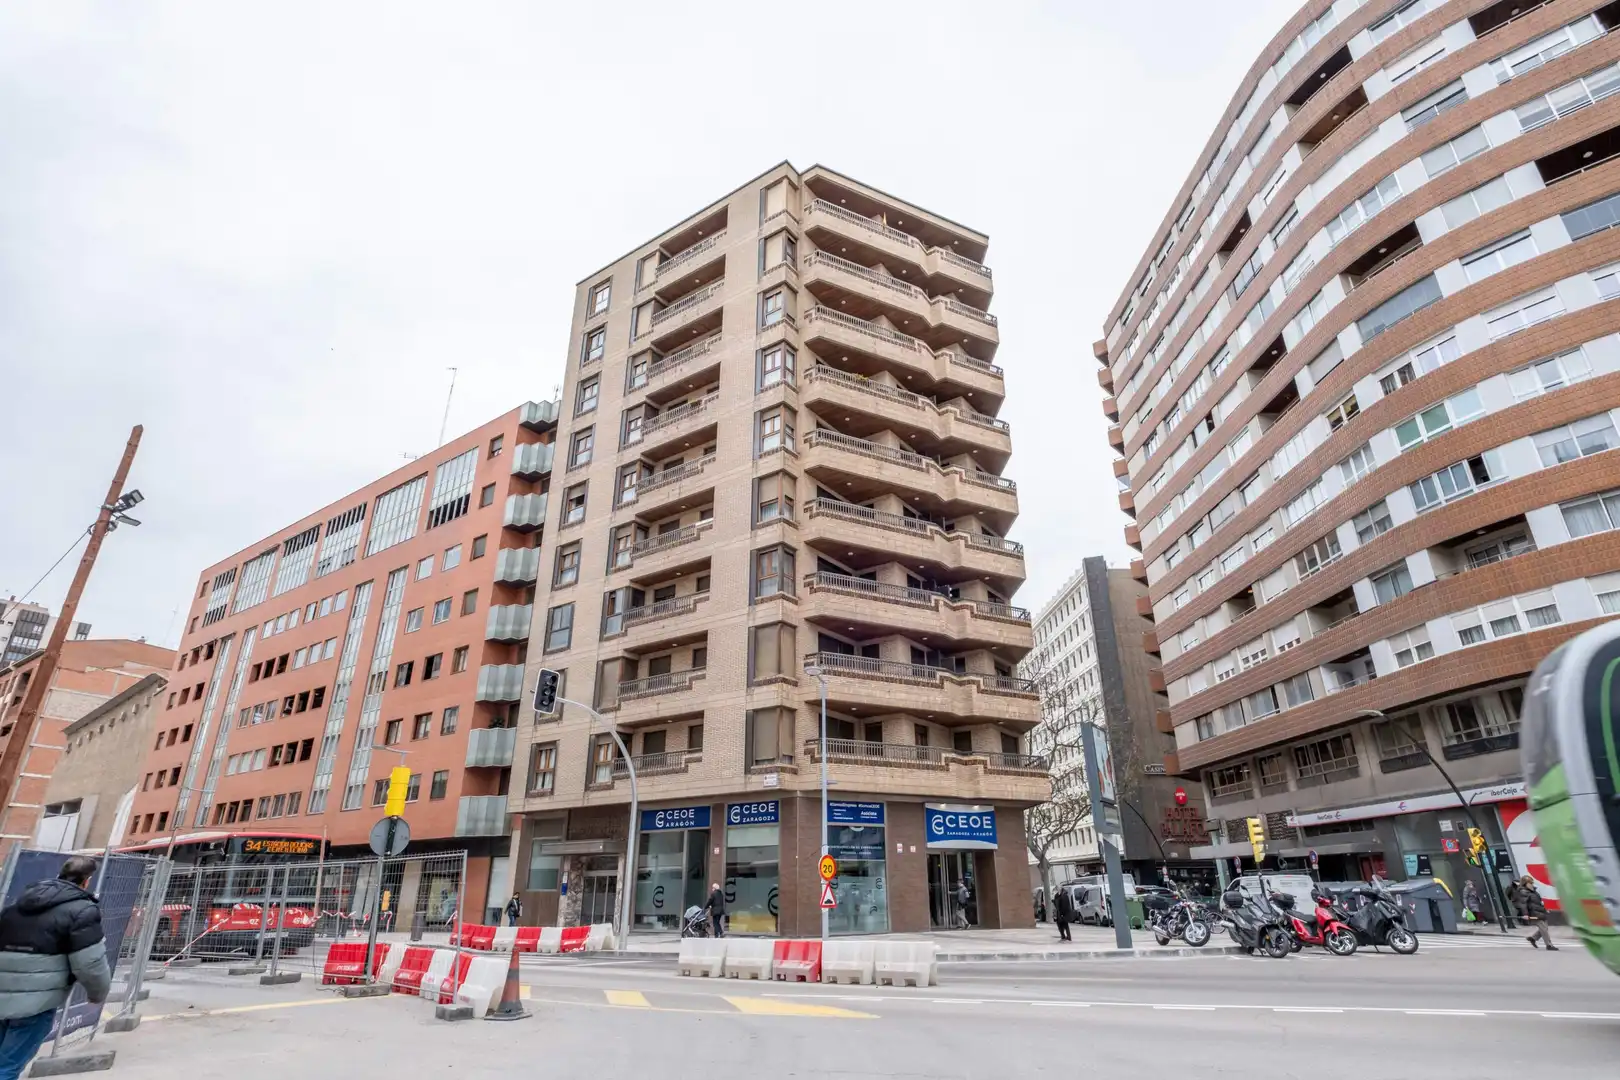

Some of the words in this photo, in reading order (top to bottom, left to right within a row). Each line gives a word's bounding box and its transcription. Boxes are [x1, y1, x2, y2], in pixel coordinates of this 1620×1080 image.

[1144, 764, 1167, 773] CASIN
[666, 808, 695, 820] CEOE
[742, 802, 776, 814] CEOE
[665, 820, 695, 829] ARAGÓN
[945, 814, 993, 829] CEOE
[245, 839, 262, 852] 34
[823, 864, 833, 874] 20
